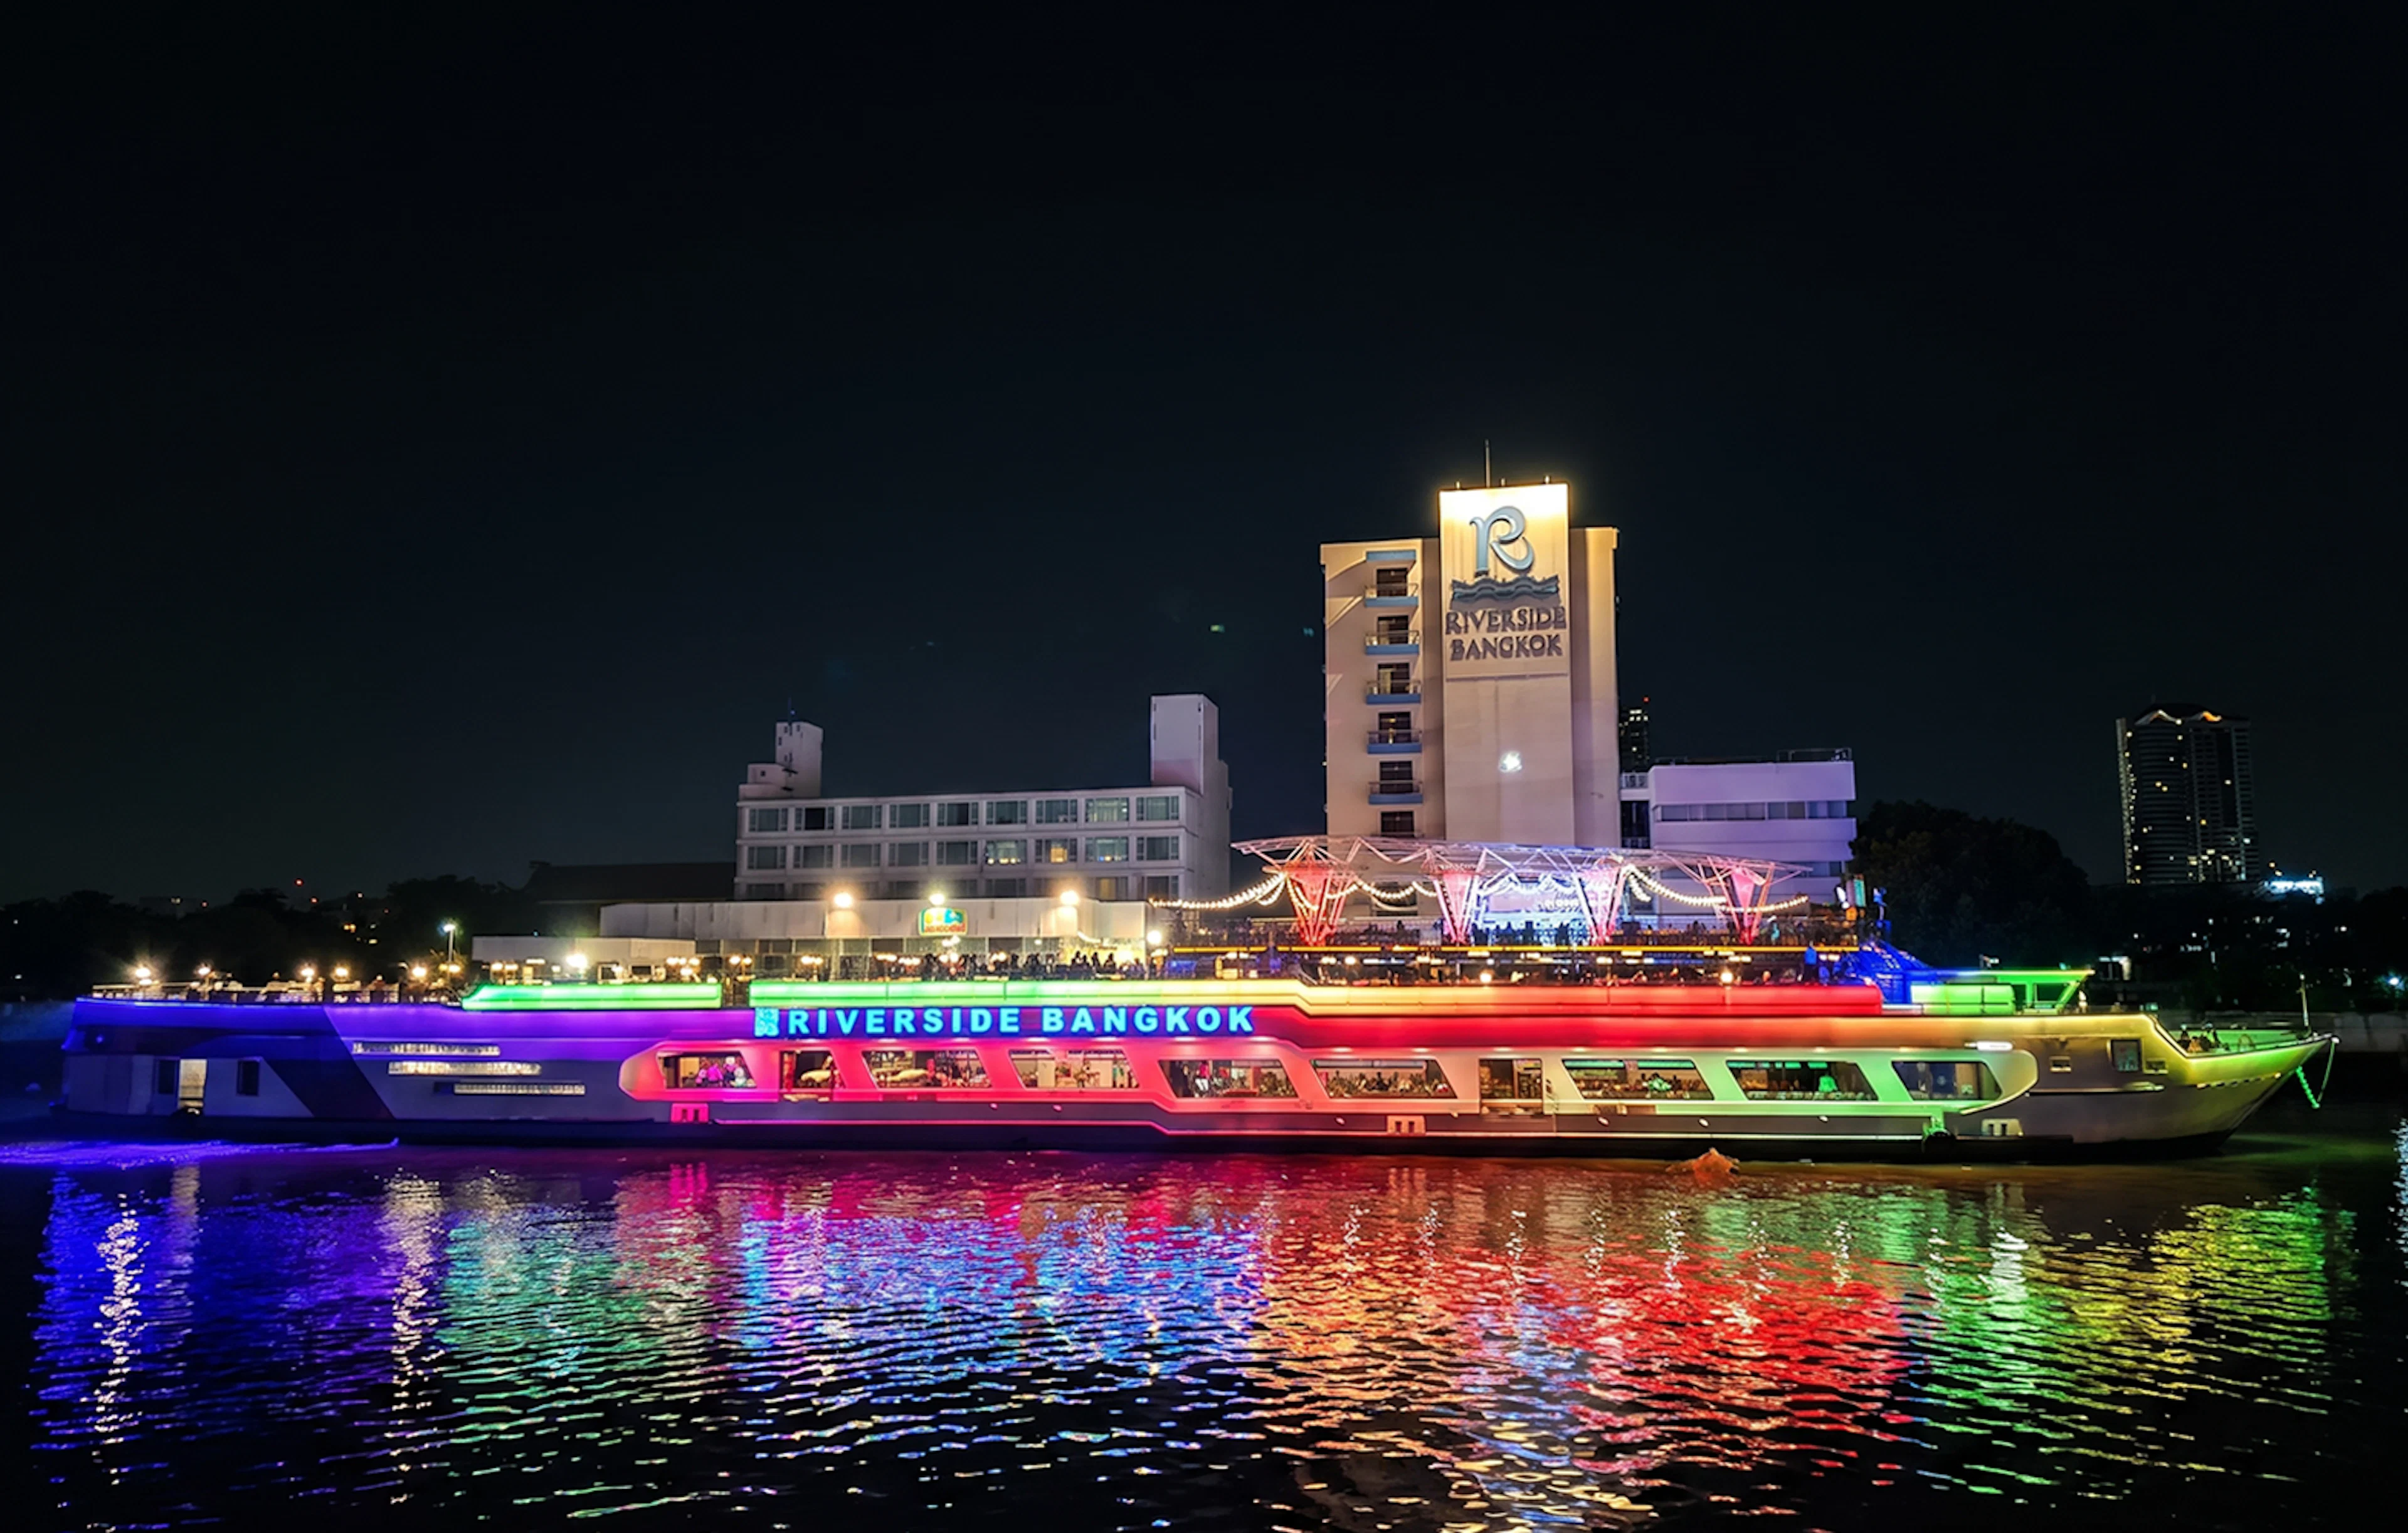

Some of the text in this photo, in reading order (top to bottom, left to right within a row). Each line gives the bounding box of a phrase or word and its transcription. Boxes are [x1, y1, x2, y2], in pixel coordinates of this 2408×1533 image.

[1445, 607, 1566, 634] RIVERSIDE
[1450, 634, 1563, 661] BANGKOK
[788, 1006, 1254, 1035] RIVERSIDE BANGKOK
